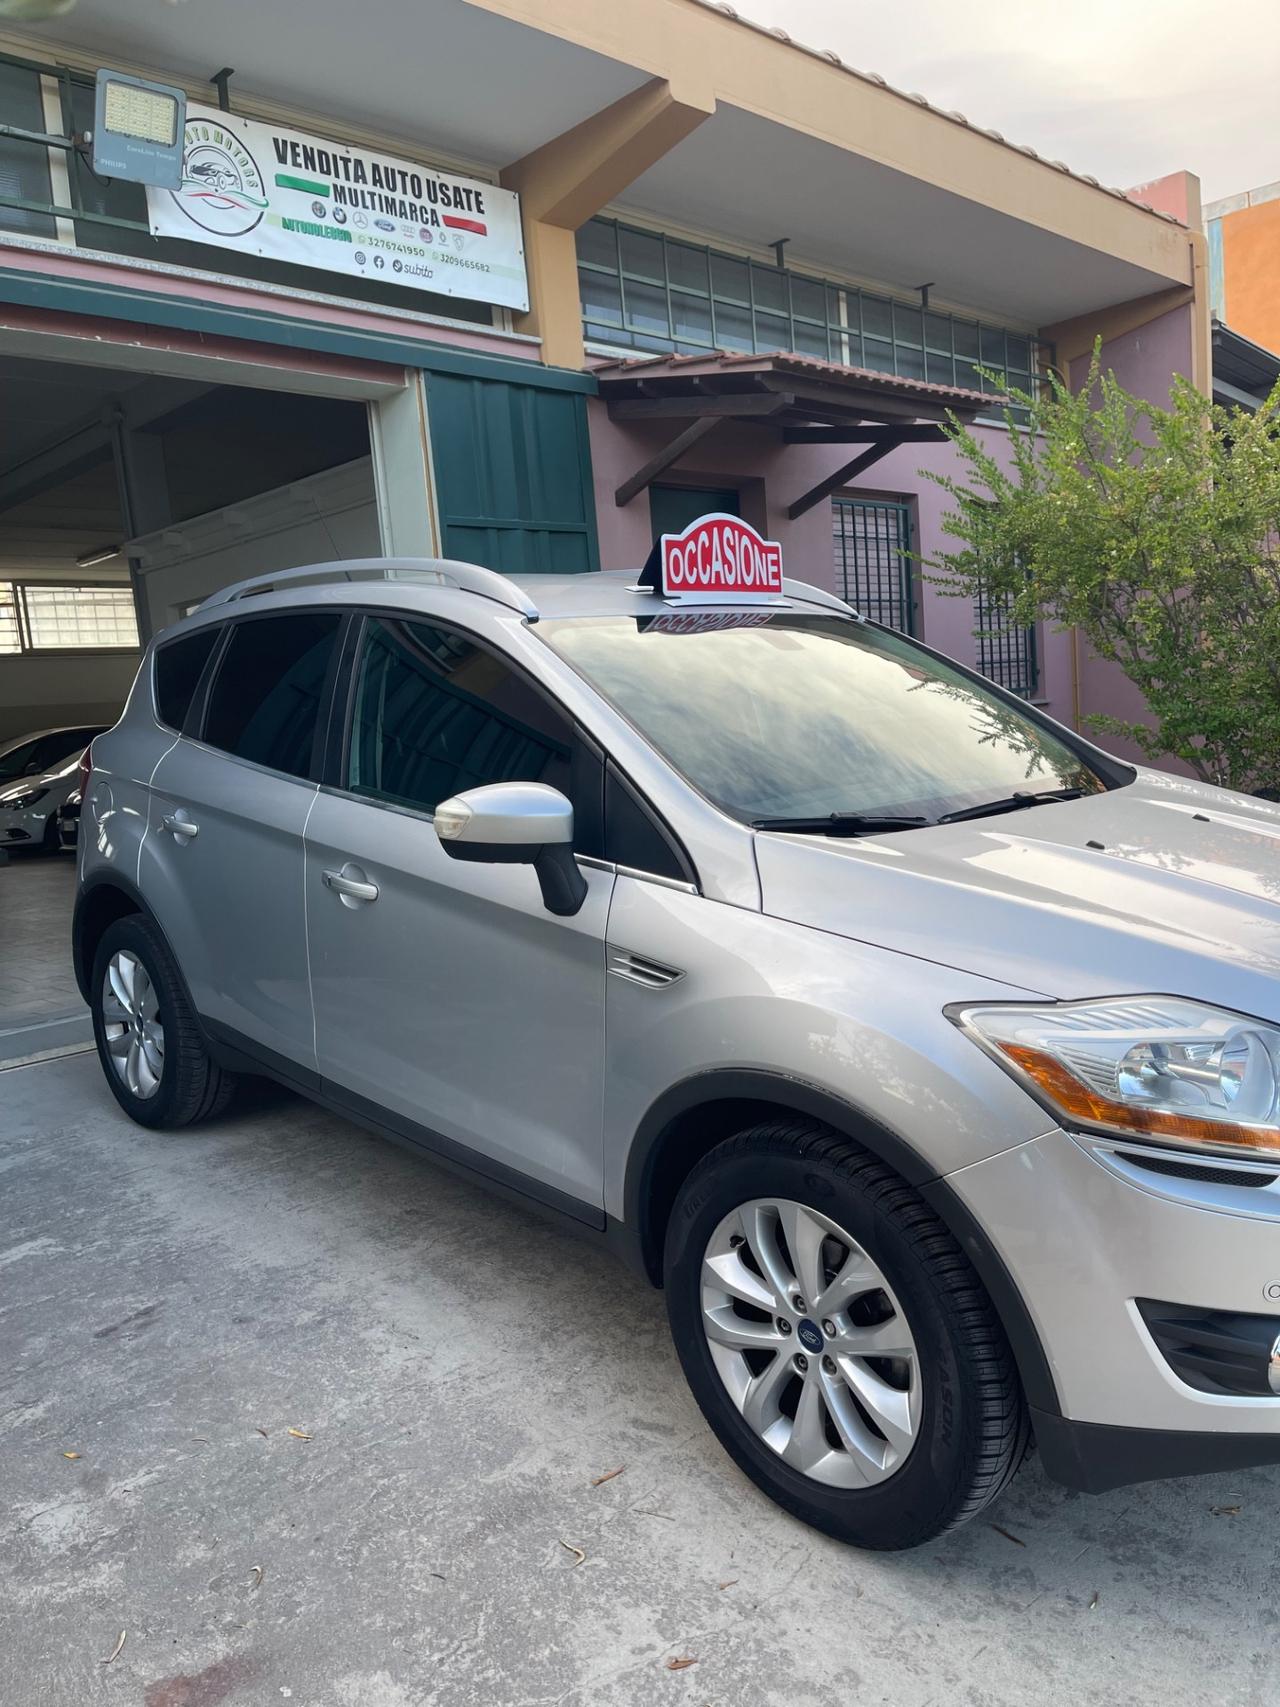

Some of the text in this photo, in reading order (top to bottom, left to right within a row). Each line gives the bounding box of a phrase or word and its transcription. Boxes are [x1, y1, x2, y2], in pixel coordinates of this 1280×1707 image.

[100, 158, 127, 169] PHILIPS
[213, 129, 259, 188] MOTORS
[272, 137, 485, 215] VENDITA AUTO USATE
[332, 183, 441, 228] MULTIMARCA
[367, 236, 491, 273] 3276741950 3209665682
[403, 262, 434, 279] subito
[669, 526, 780, 586] OCCASIONE
